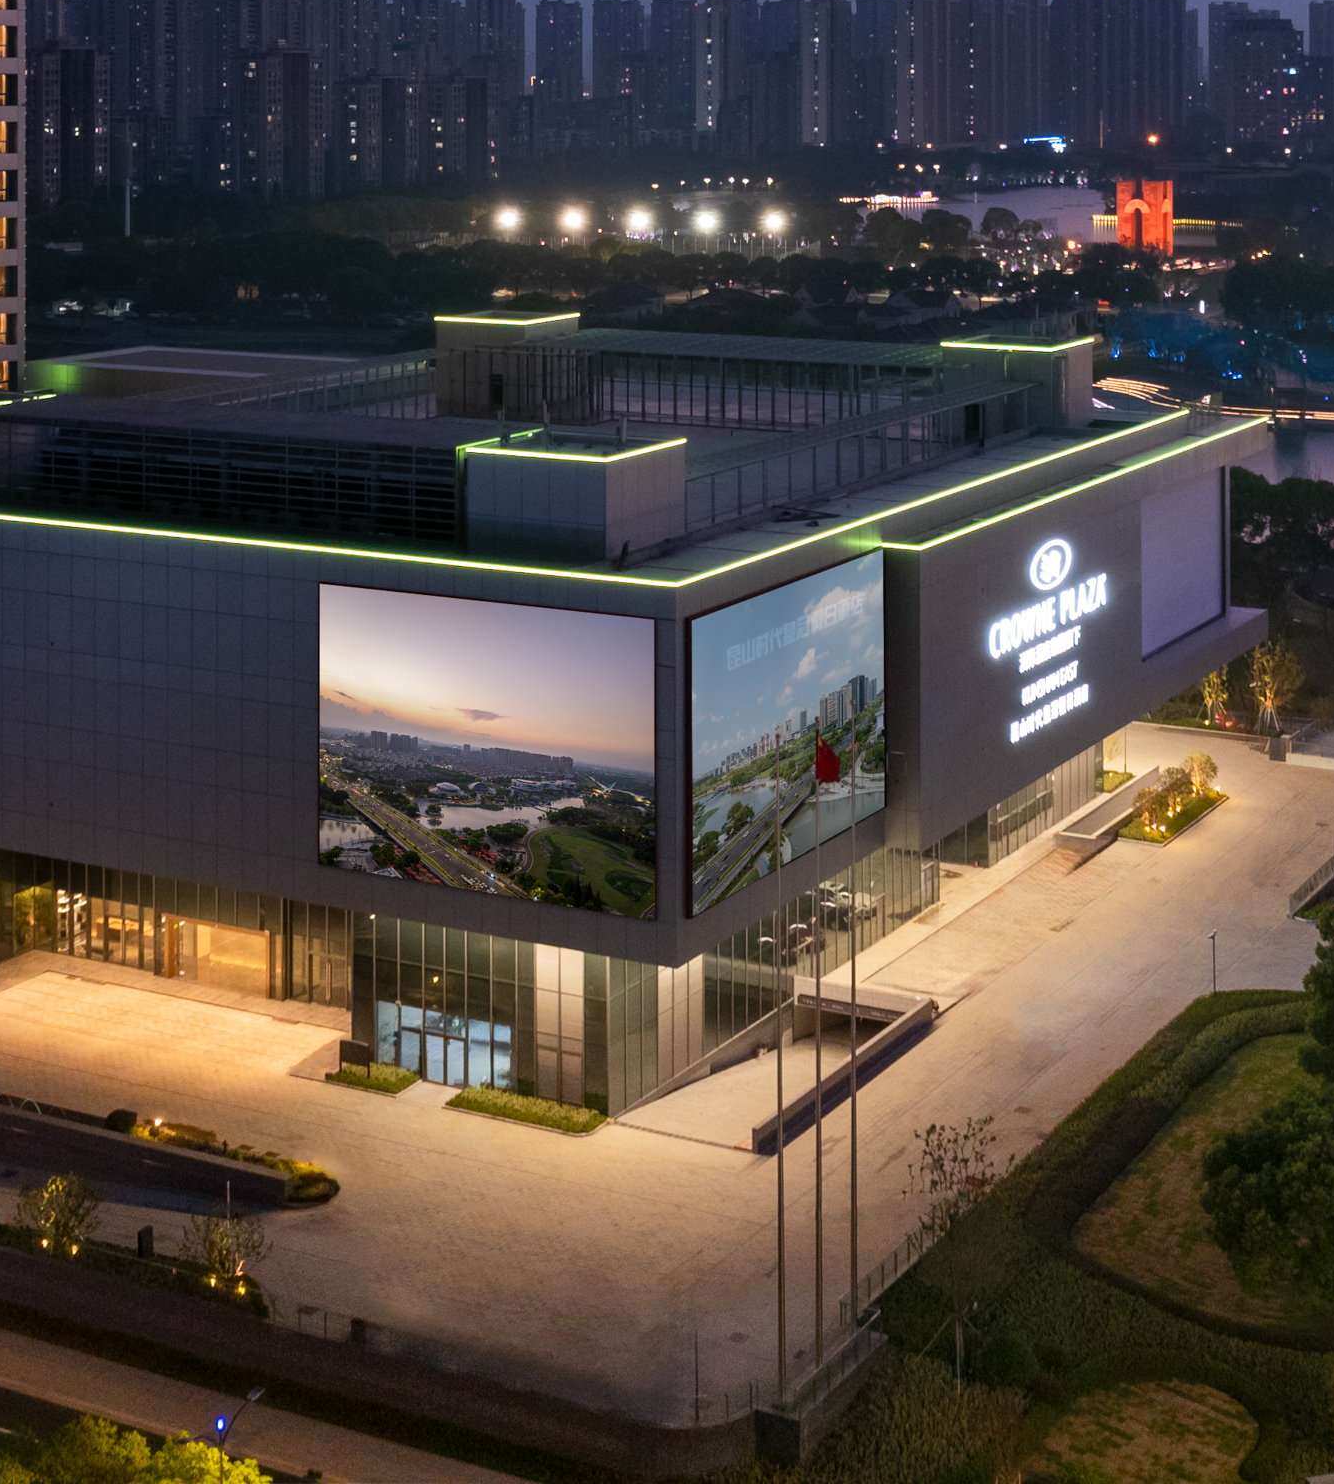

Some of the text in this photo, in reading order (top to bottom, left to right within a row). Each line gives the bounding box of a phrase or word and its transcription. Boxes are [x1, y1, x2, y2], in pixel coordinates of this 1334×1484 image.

[726, 590, 867, 671] 昆山时代皇冠假日酒店
[988, 596, 1057, 660] CROWNE
[1059, 572, 1108, 626] PLAZA
